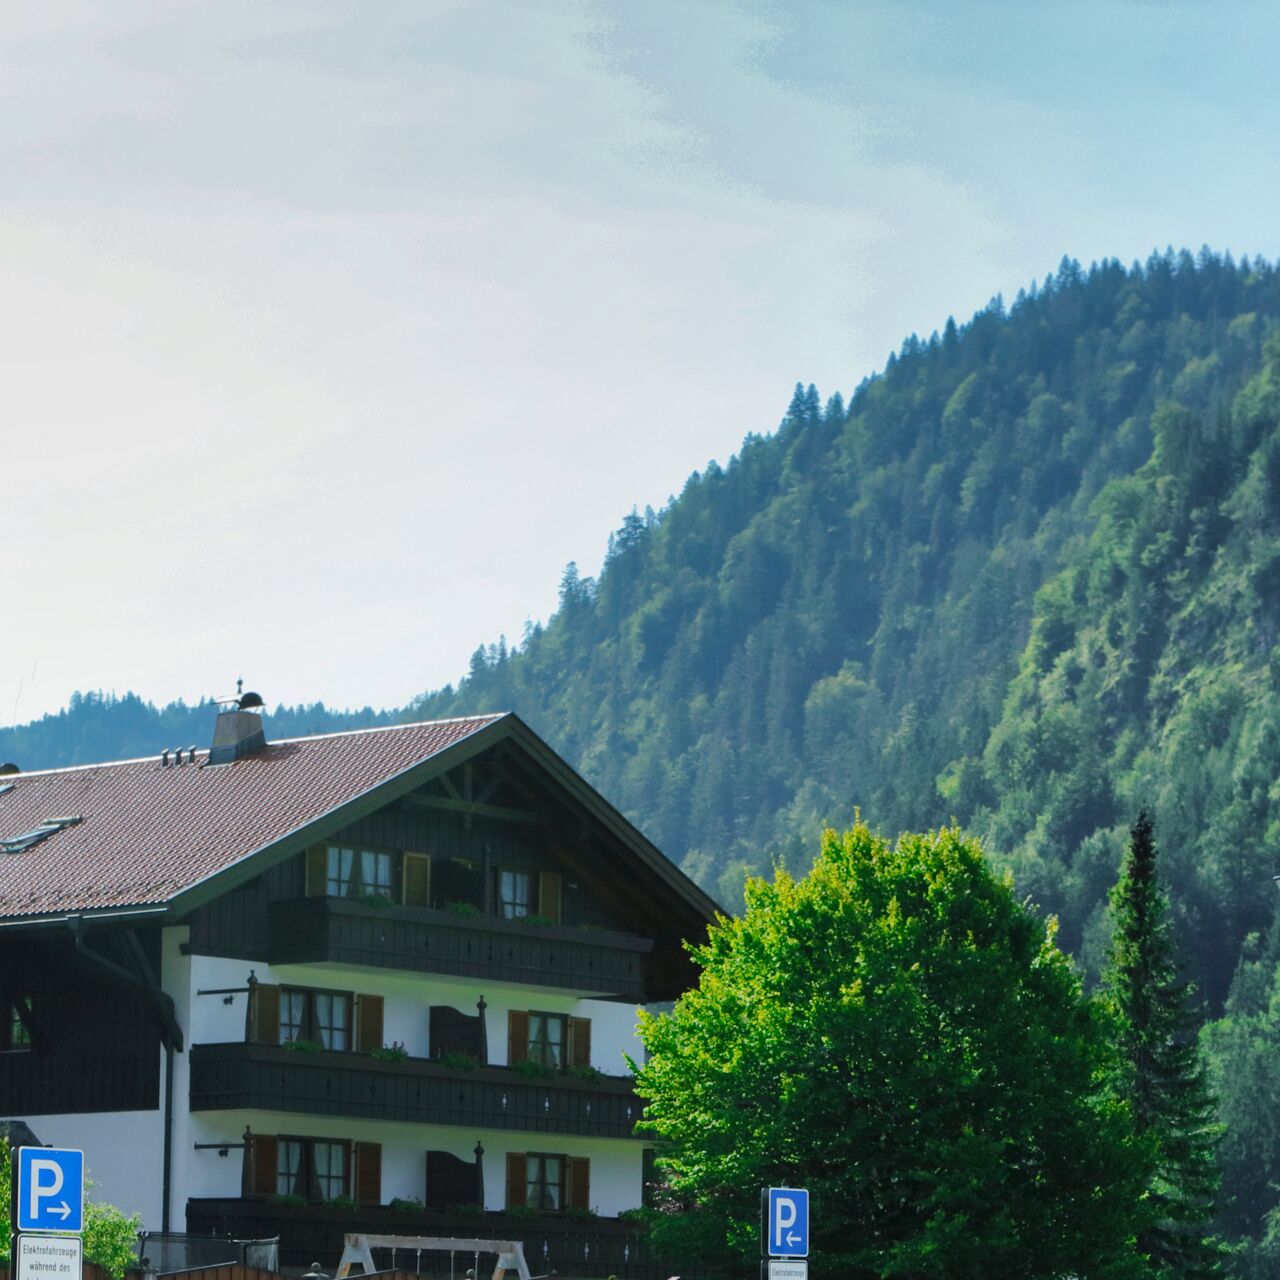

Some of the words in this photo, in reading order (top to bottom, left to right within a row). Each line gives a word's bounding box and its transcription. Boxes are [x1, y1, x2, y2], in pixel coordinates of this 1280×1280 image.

[30, 1159, 64, 1219] P
[776, 1198, 797, 1246] P
[22, 1243, 77, 1259] Elektrofahrzeuge
[29, 1261, 57, 1273] während
[59, 1261, 71, 1273] des
